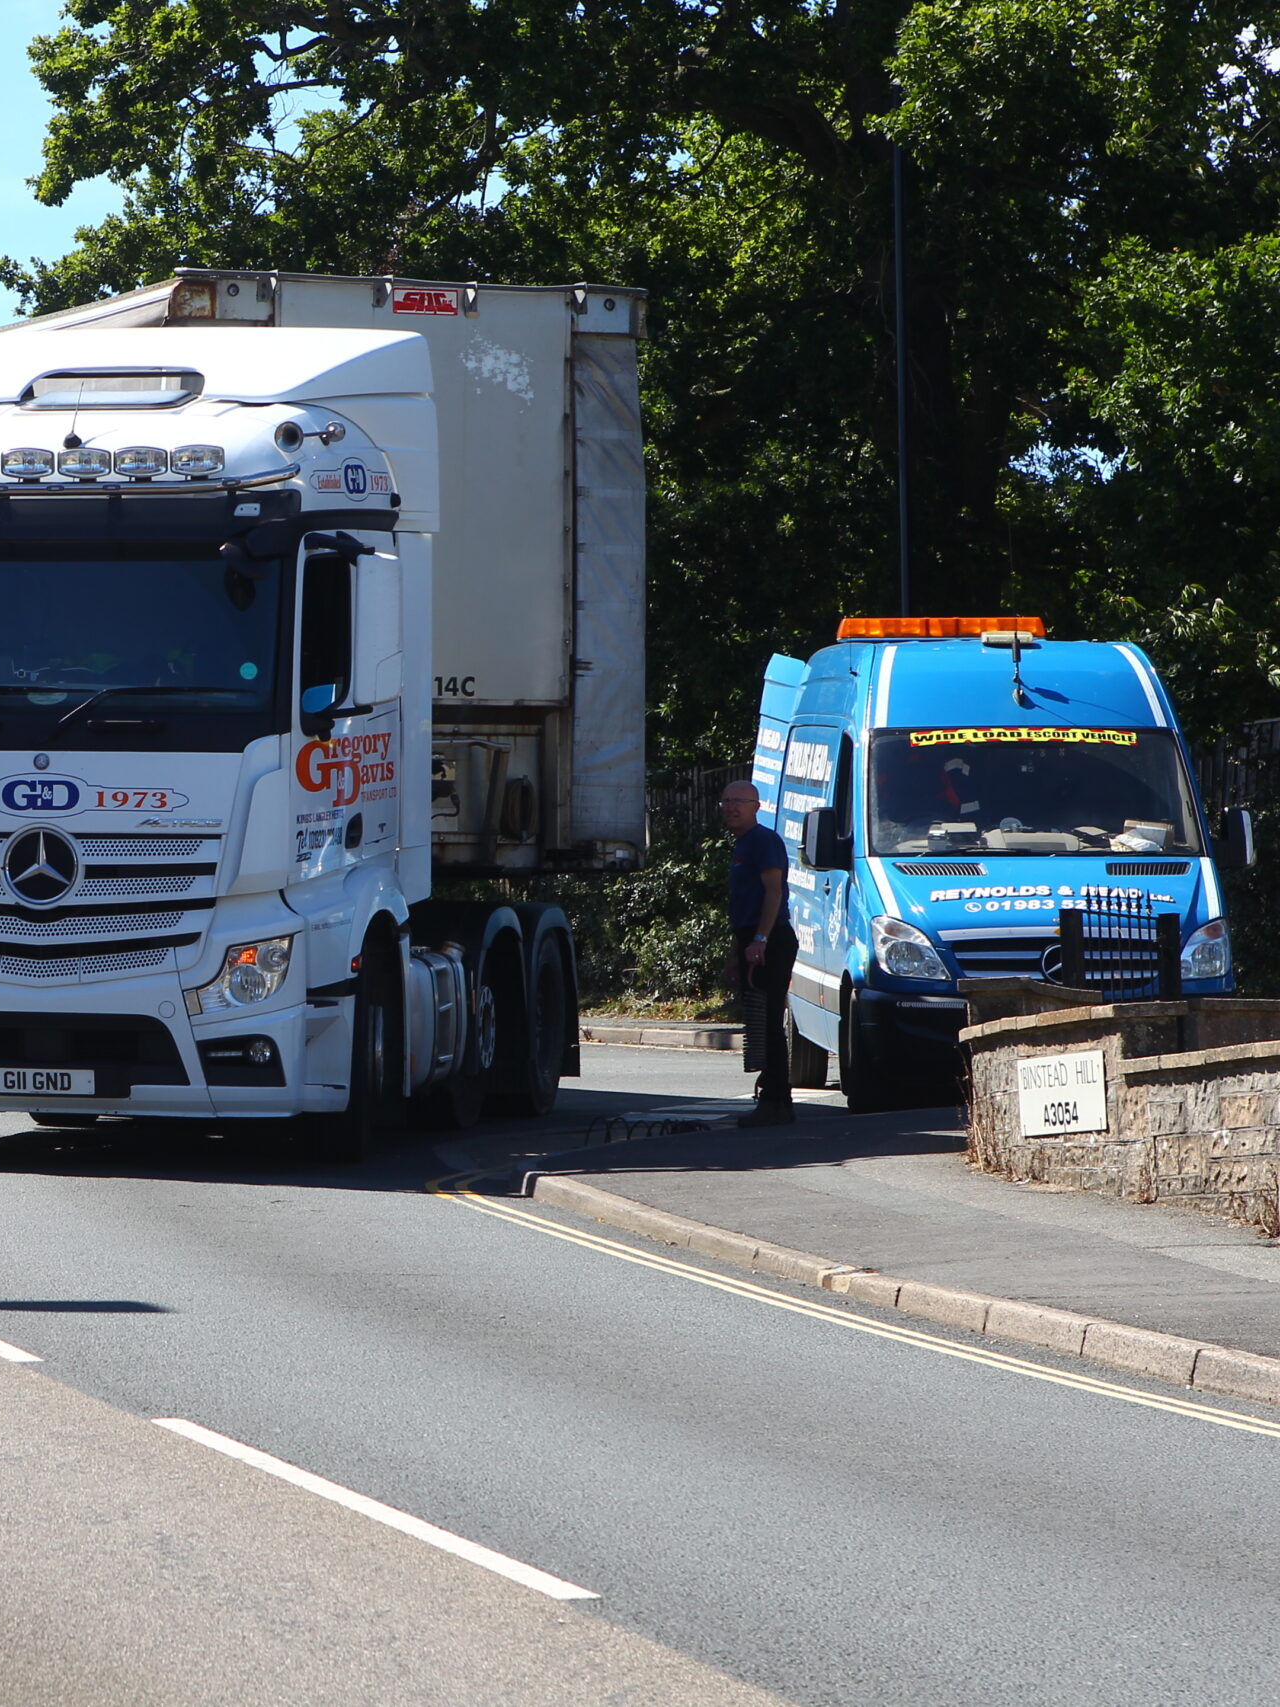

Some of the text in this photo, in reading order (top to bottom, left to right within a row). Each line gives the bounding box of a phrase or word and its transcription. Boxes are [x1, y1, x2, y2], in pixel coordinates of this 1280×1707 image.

[370, 475, 389, 492] 1973
[434, 676, 475, 697] 14C
[914, 730, 1135, 744] WIDE LOAD ESCORT VEHICLE
[1, 779, 80, 811] G&D
[95, 791, 168, 809] 1973
[930, 885, 1052, 902] REYNOLDS
[1057, 885, 1074, 897] &
[1150, 892, 1176, 903] Ltd.
[985, 900, 1055, 912] 01983
[32, 1072, 72, 1091] GND
[1022, 1060, 1097, 1090] BINSTEAD HILL
[1044, 1101, 1079, 1127] A3054
